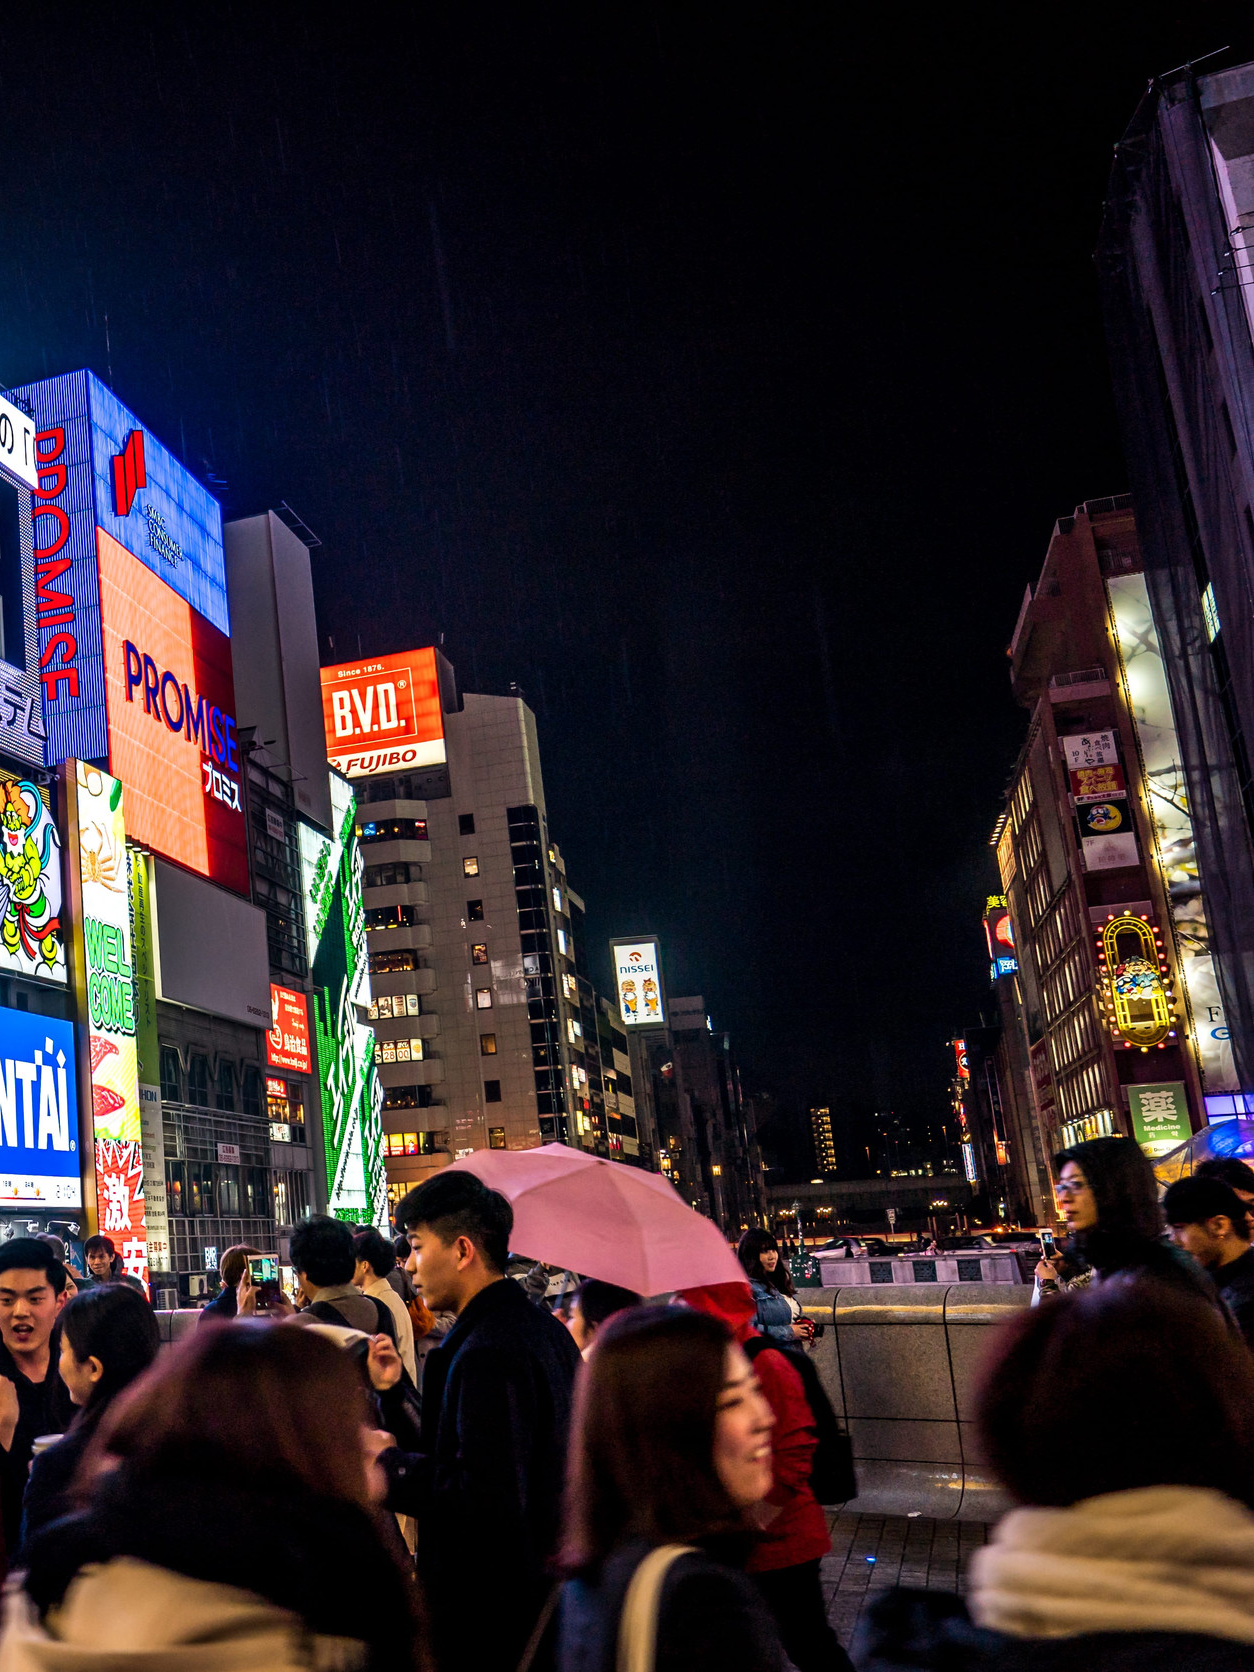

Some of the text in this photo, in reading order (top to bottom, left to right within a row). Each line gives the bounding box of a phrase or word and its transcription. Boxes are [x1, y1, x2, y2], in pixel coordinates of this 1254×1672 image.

[148, 519, 183, 561] CONSUMER
[150, 533, 178, 569] FINANCE
[338, 664, 385, 678] Since 1876.
[122, 640, 238, 773] PROMISE
[332, 682, 406, 738] B.V.D.
[346, 749, 417, 773] FUJIBO
[202, 761, 242, 812] プロミス
[620, 964, 654, 974] NISSEI
[1139, 1091, 1178, 1122] 薬
